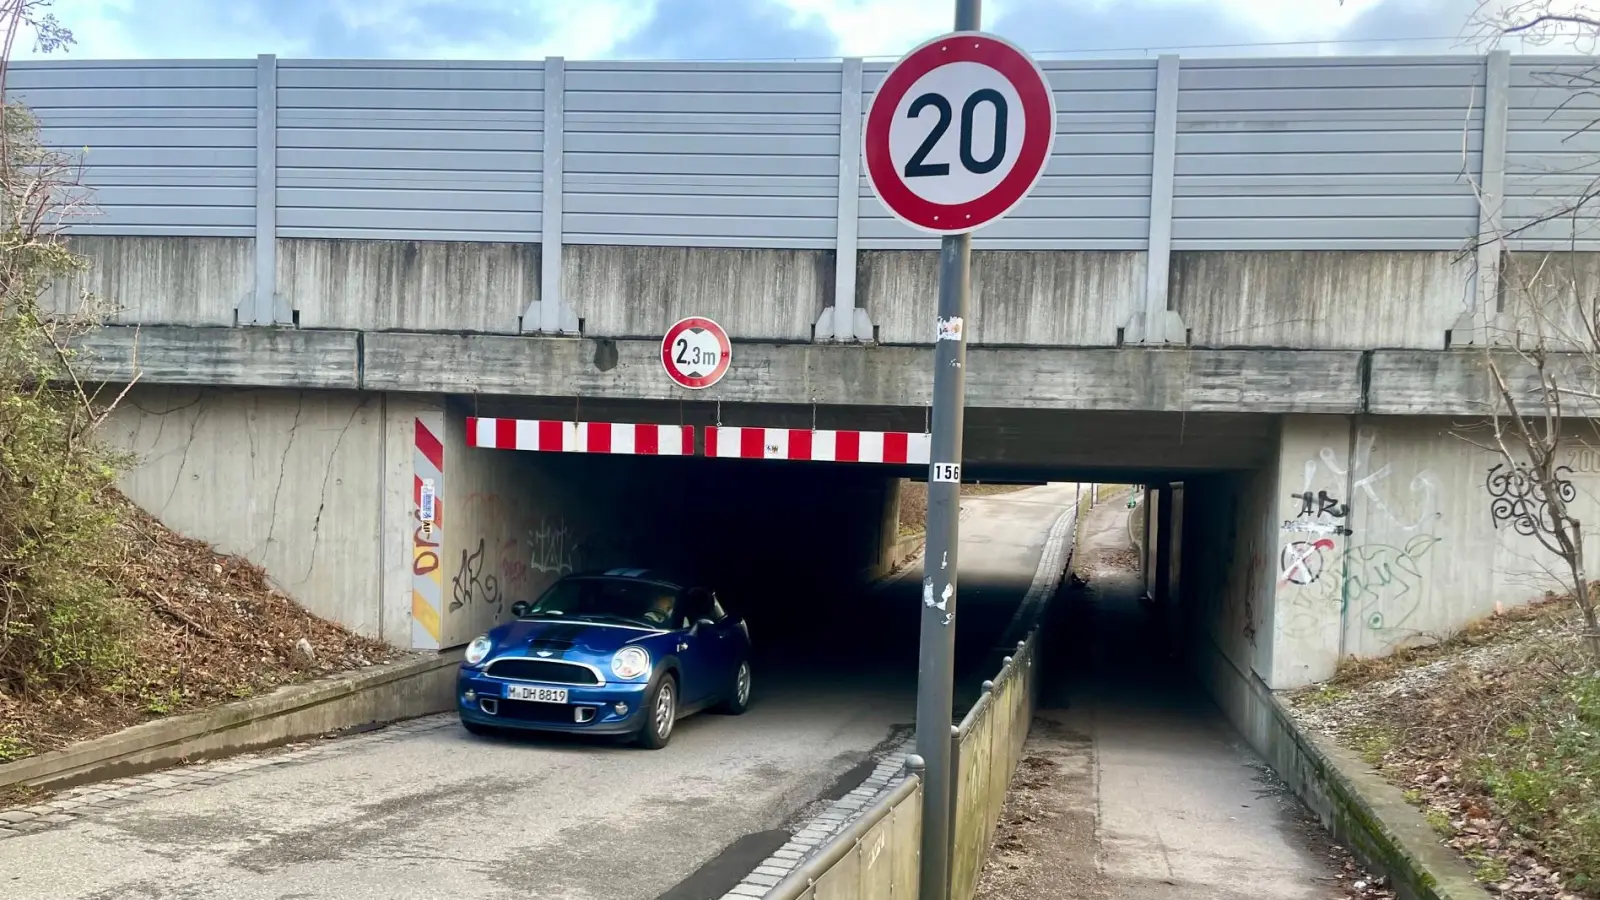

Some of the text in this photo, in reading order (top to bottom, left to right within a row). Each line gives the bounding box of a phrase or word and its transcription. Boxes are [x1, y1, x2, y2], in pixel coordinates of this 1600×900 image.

[904, 88, 1008, 177] 20
[936, 465, 959, 480] 156
[522, 687, 537, 700] DH
[539, 688, 566, 702] 8819
